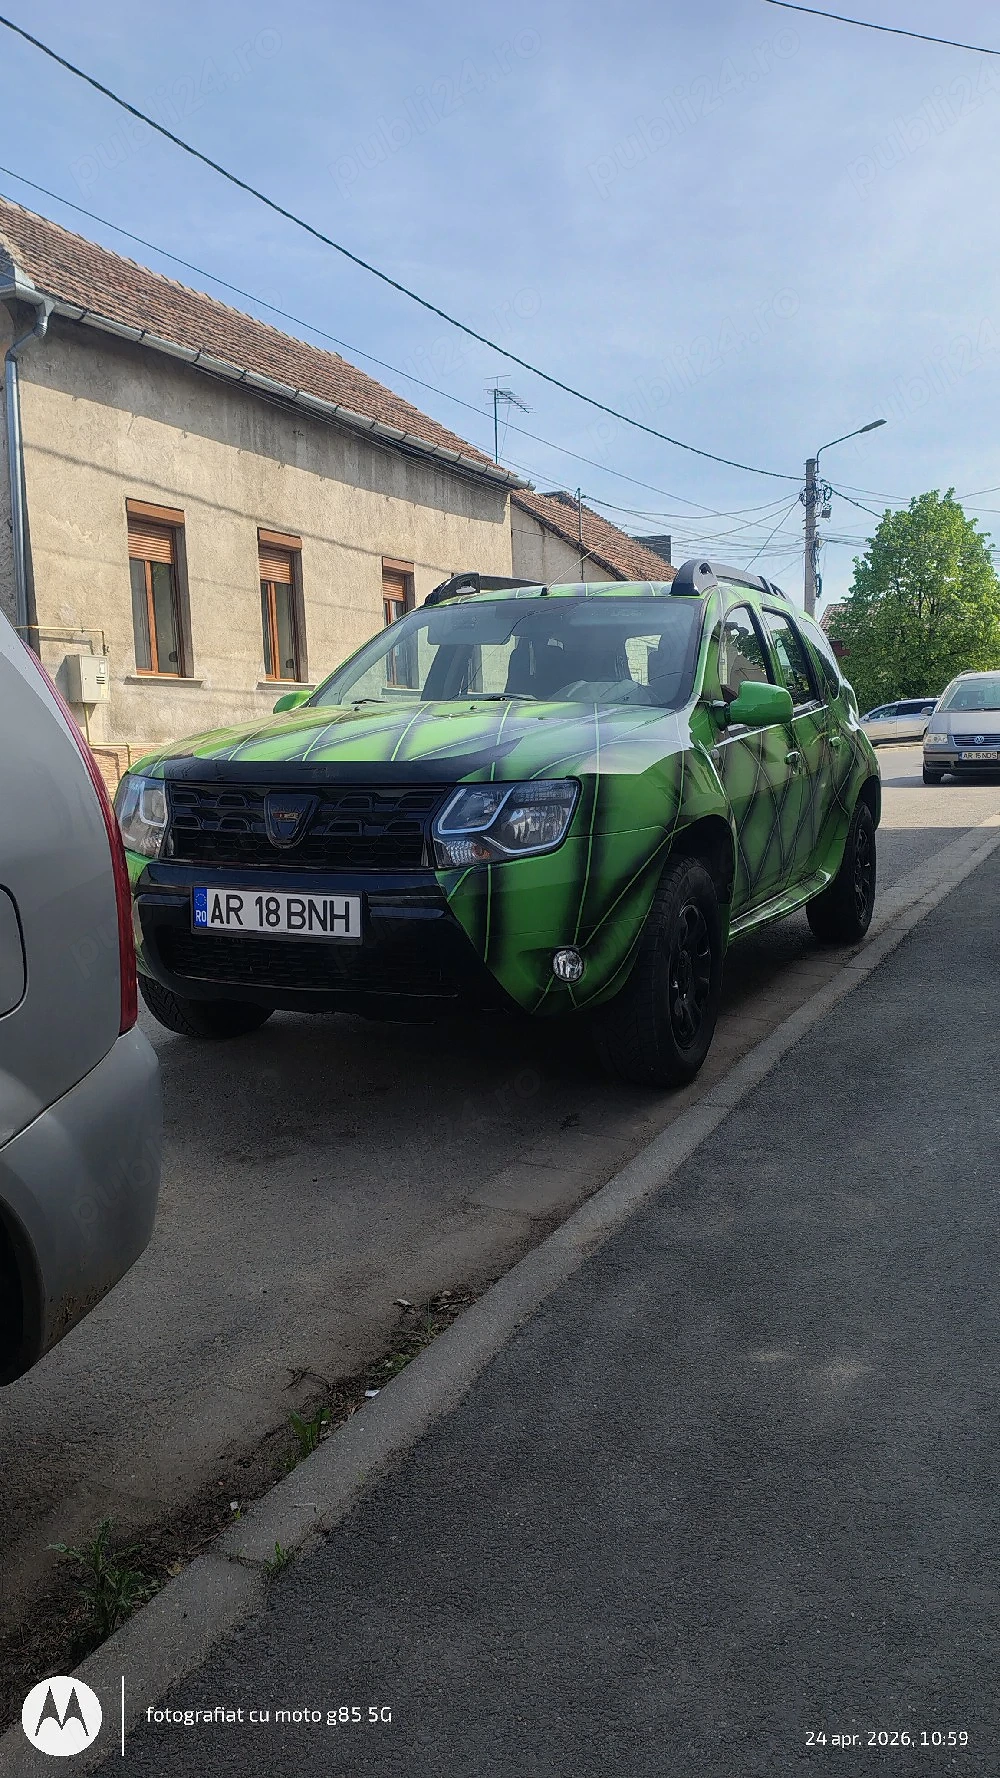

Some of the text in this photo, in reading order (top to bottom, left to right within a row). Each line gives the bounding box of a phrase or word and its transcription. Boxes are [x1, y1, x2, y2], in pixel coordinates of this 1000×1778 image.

[195, 909, 206, 923] RO
[210, 893, 350, 933] AR 18 BNH
